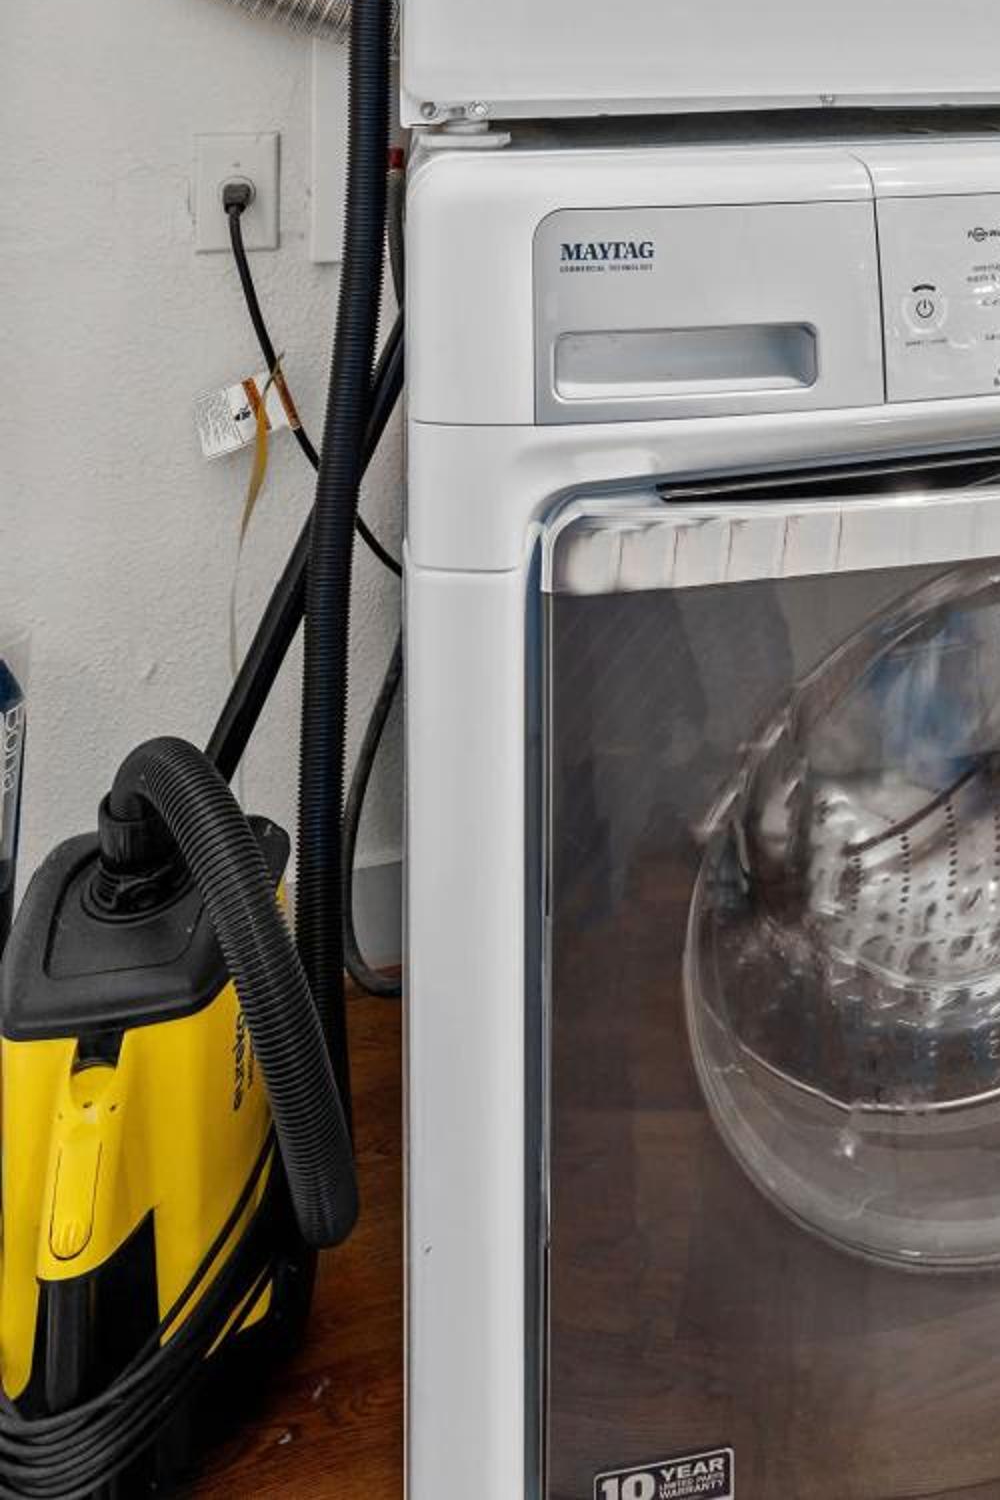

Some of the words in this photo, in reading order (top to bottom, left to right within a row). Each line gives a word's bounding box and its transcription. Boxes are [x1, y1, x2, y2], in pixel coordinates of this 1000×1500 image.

[560, 241, 655, 261] MAYTAG
[600, 1472, 656, 1500] 10
[659, 1456, 726, 1482] YEAR
